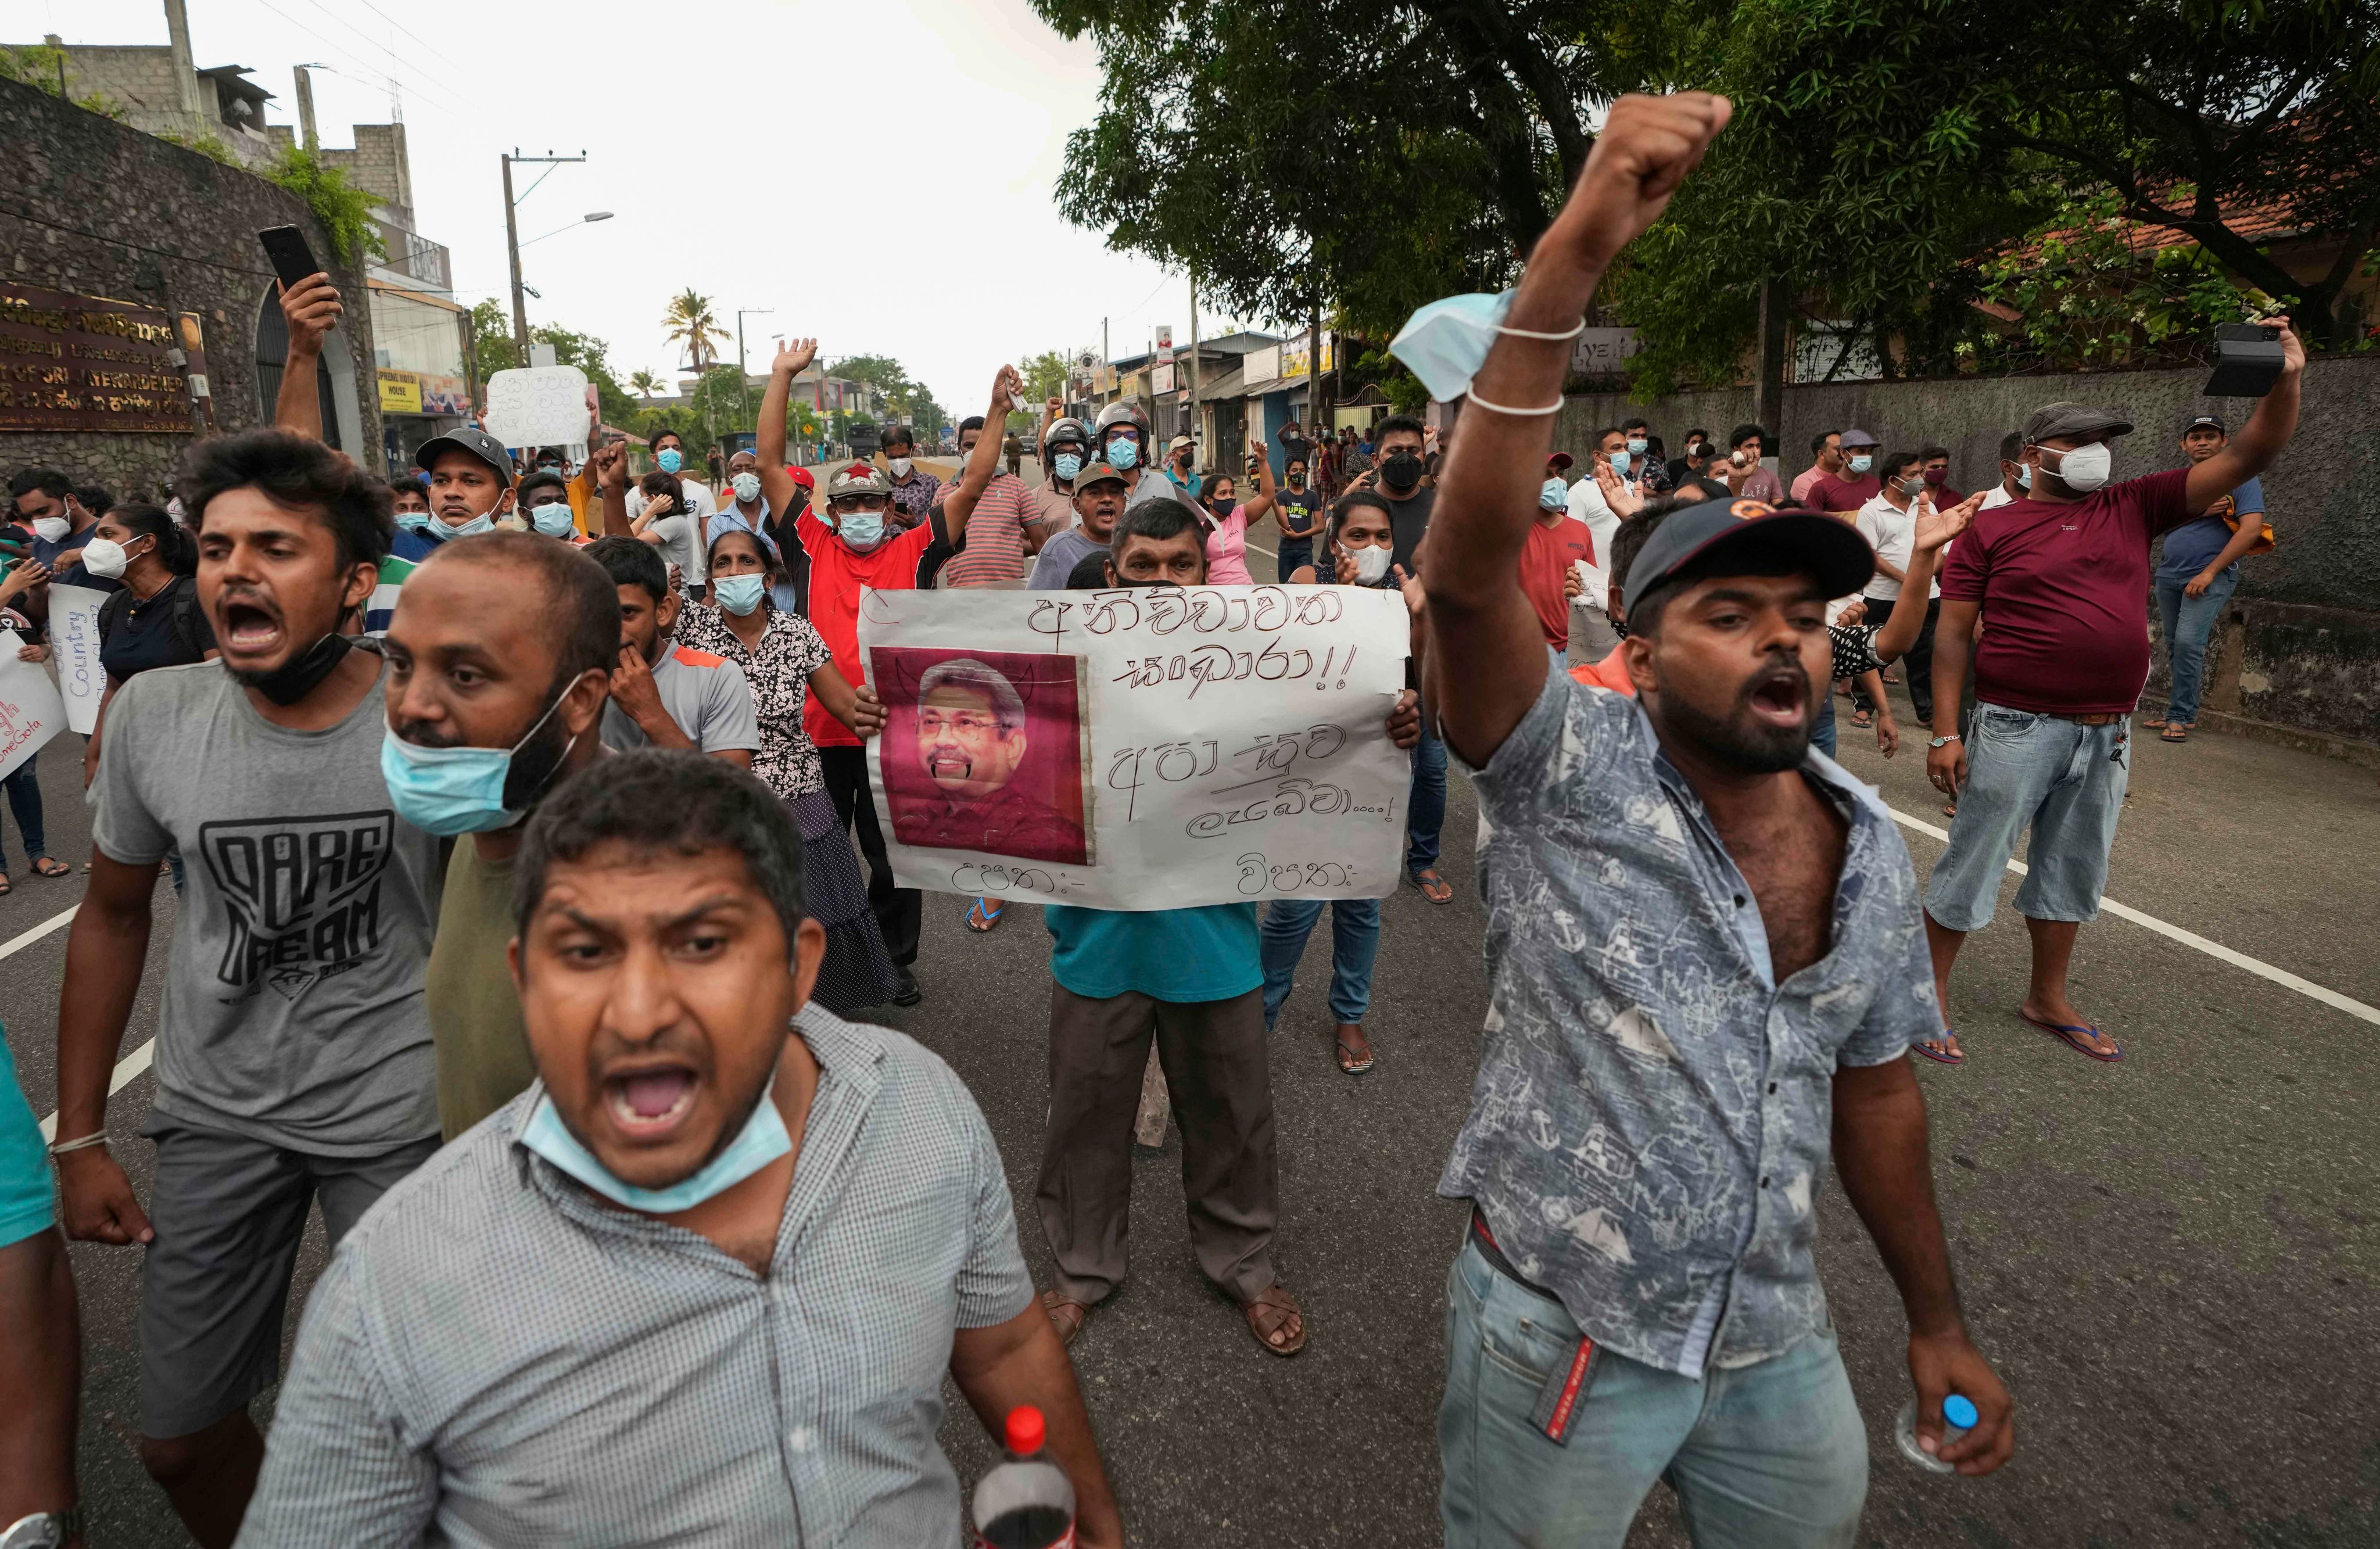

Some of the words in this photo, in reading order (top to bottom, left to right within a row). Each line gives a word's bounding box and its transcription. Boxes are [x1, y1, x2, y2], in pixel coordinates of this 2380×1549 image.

[41, 366, 69, 385] SRI
[388, 385, 406, 396] HOUSE
[65, 611, 90, 698] Country
[215, 826, 382, 930] DARE
[217, 876, 382, 987] DREAM
